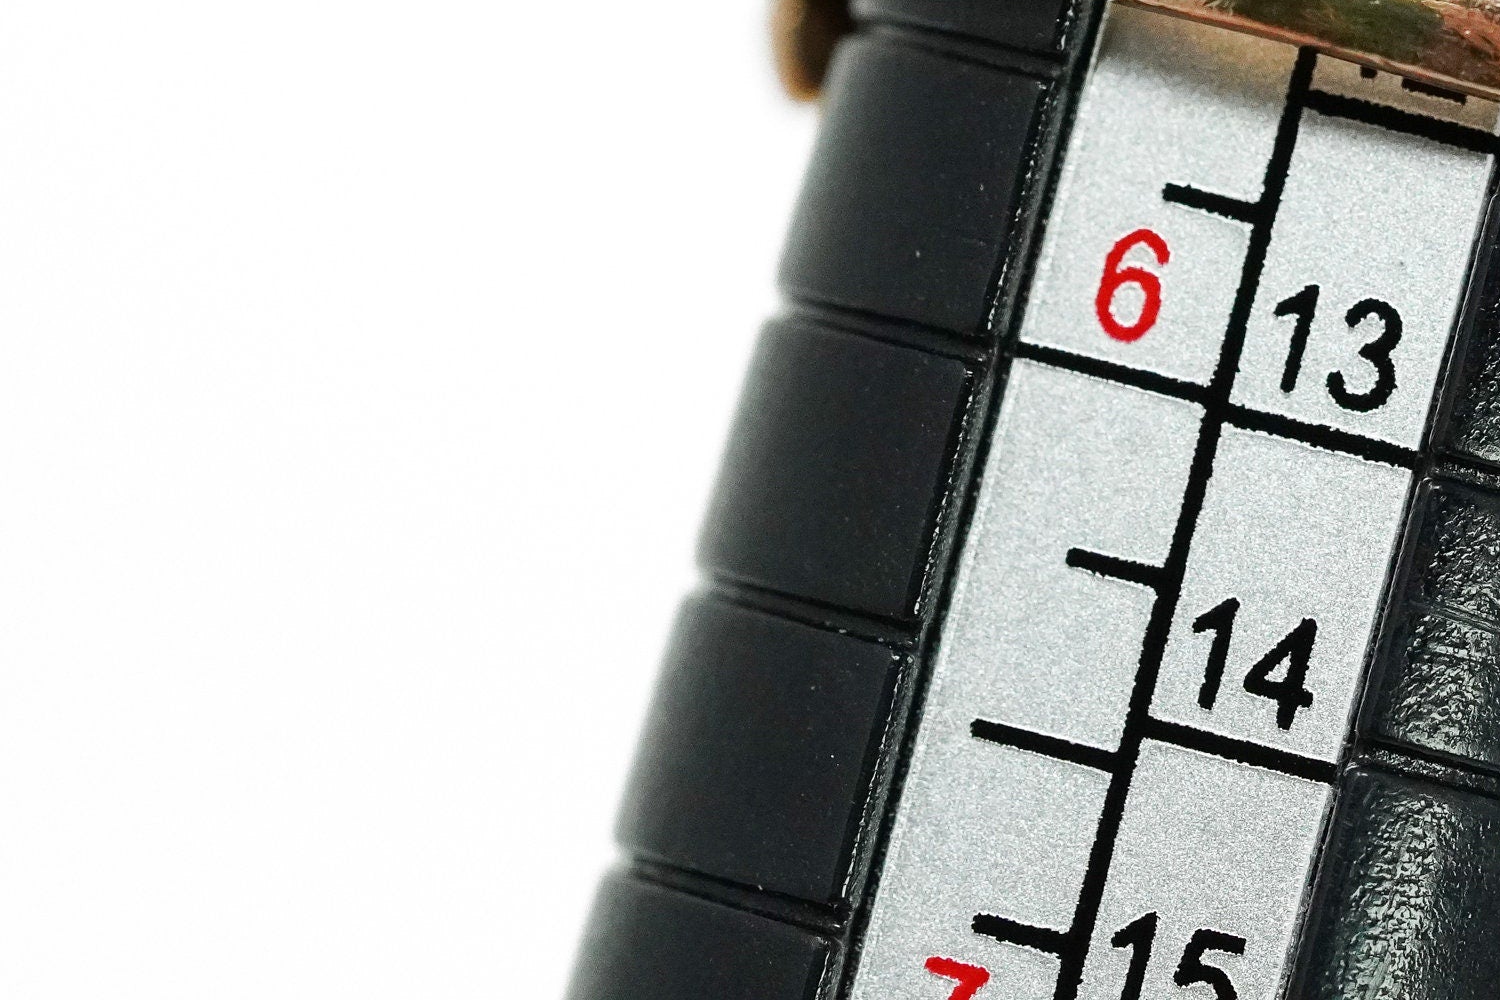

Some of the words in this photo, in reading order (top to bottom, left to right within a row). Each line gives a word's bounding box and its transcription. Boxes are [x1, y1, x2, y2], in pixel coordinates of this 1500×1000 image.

[1095, 228, 1171, 344] 6
[1272, 284, 1403, 414] 13
[1191, 597, 1318, 731] 14
[1110, 910, 1247, 1000] 15
